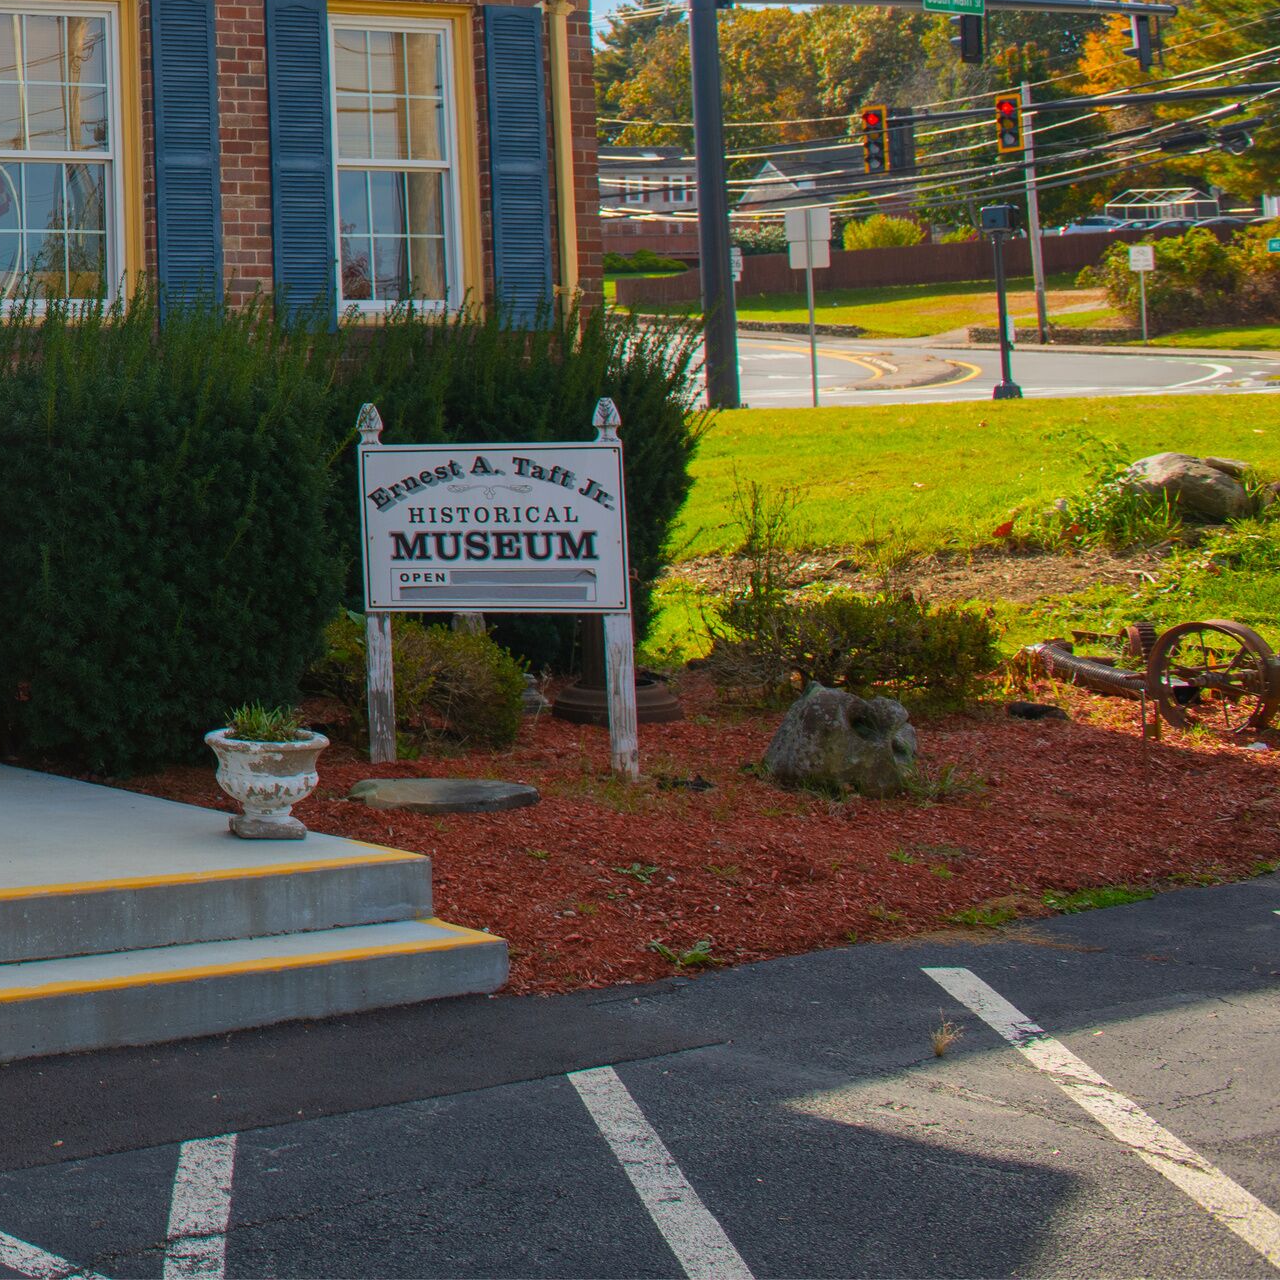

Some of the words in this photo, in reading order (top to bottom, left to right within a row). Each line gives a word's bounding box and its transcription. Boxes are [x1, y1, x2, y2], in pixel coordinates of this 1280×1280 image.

[367, 458, 461, 512] Ernest
[470, 455, 504, 475] A.
[512, 456, 576, 489] Taft
[578, 478, 614, 511] Jr.
[408, 506, 579, 523] HISTORICAL
[390, 530, 599, 561] MUSEUM
[399, 573, 446, 583] OPEN
